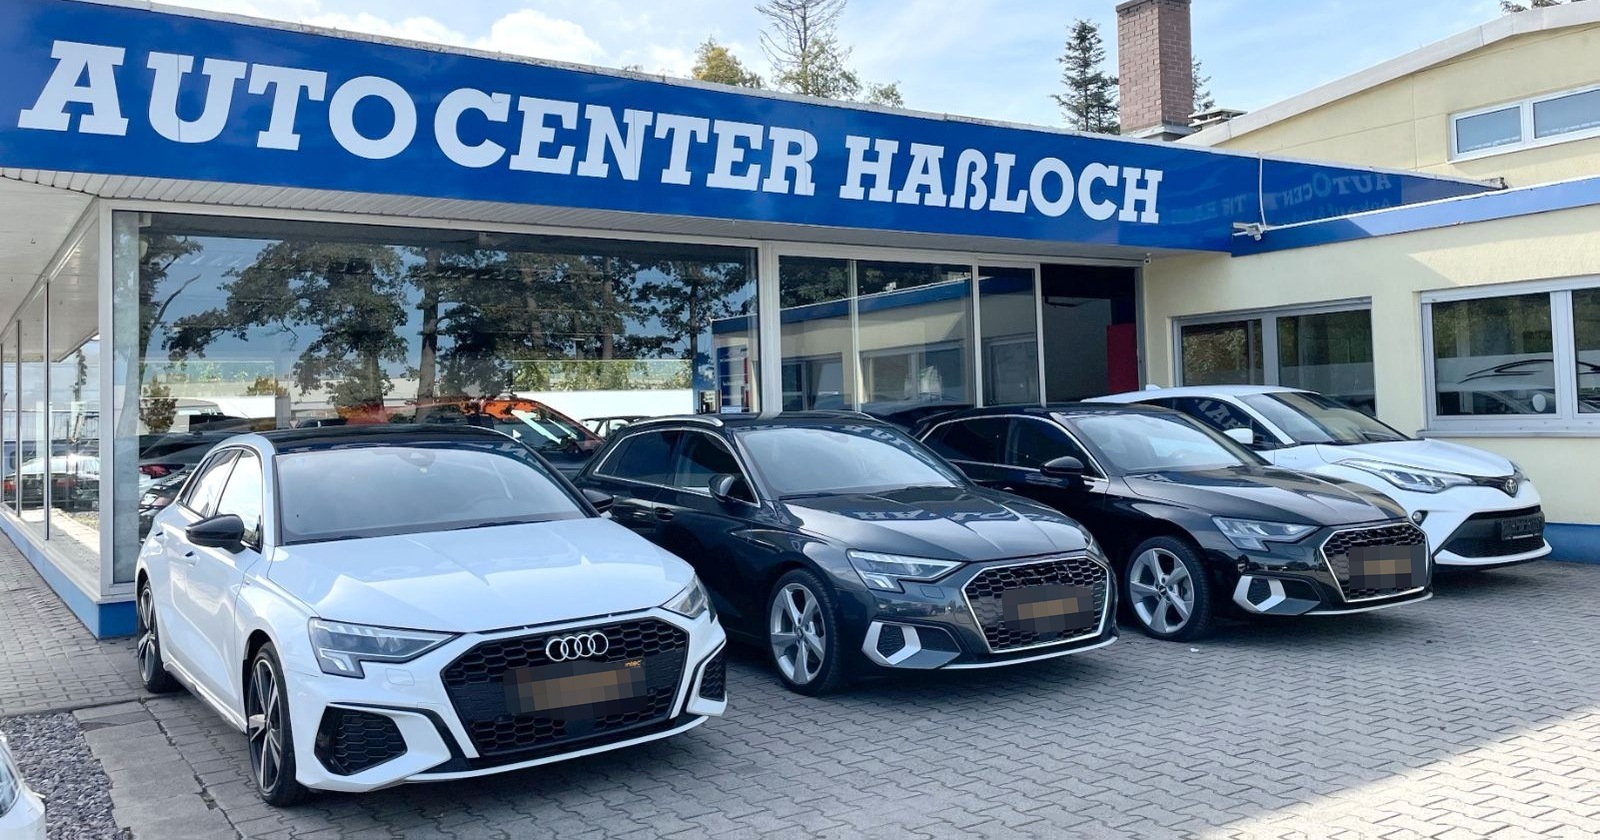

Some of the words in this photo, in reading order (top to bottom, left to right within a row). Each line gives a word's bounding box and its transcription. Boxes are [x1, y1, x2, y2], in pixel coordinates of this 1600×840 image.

[18, 40, 417, 160] AUTO
[434, 87, 818, 197] CENTER
[839, 135, 1163, 224] HAßLOCH
